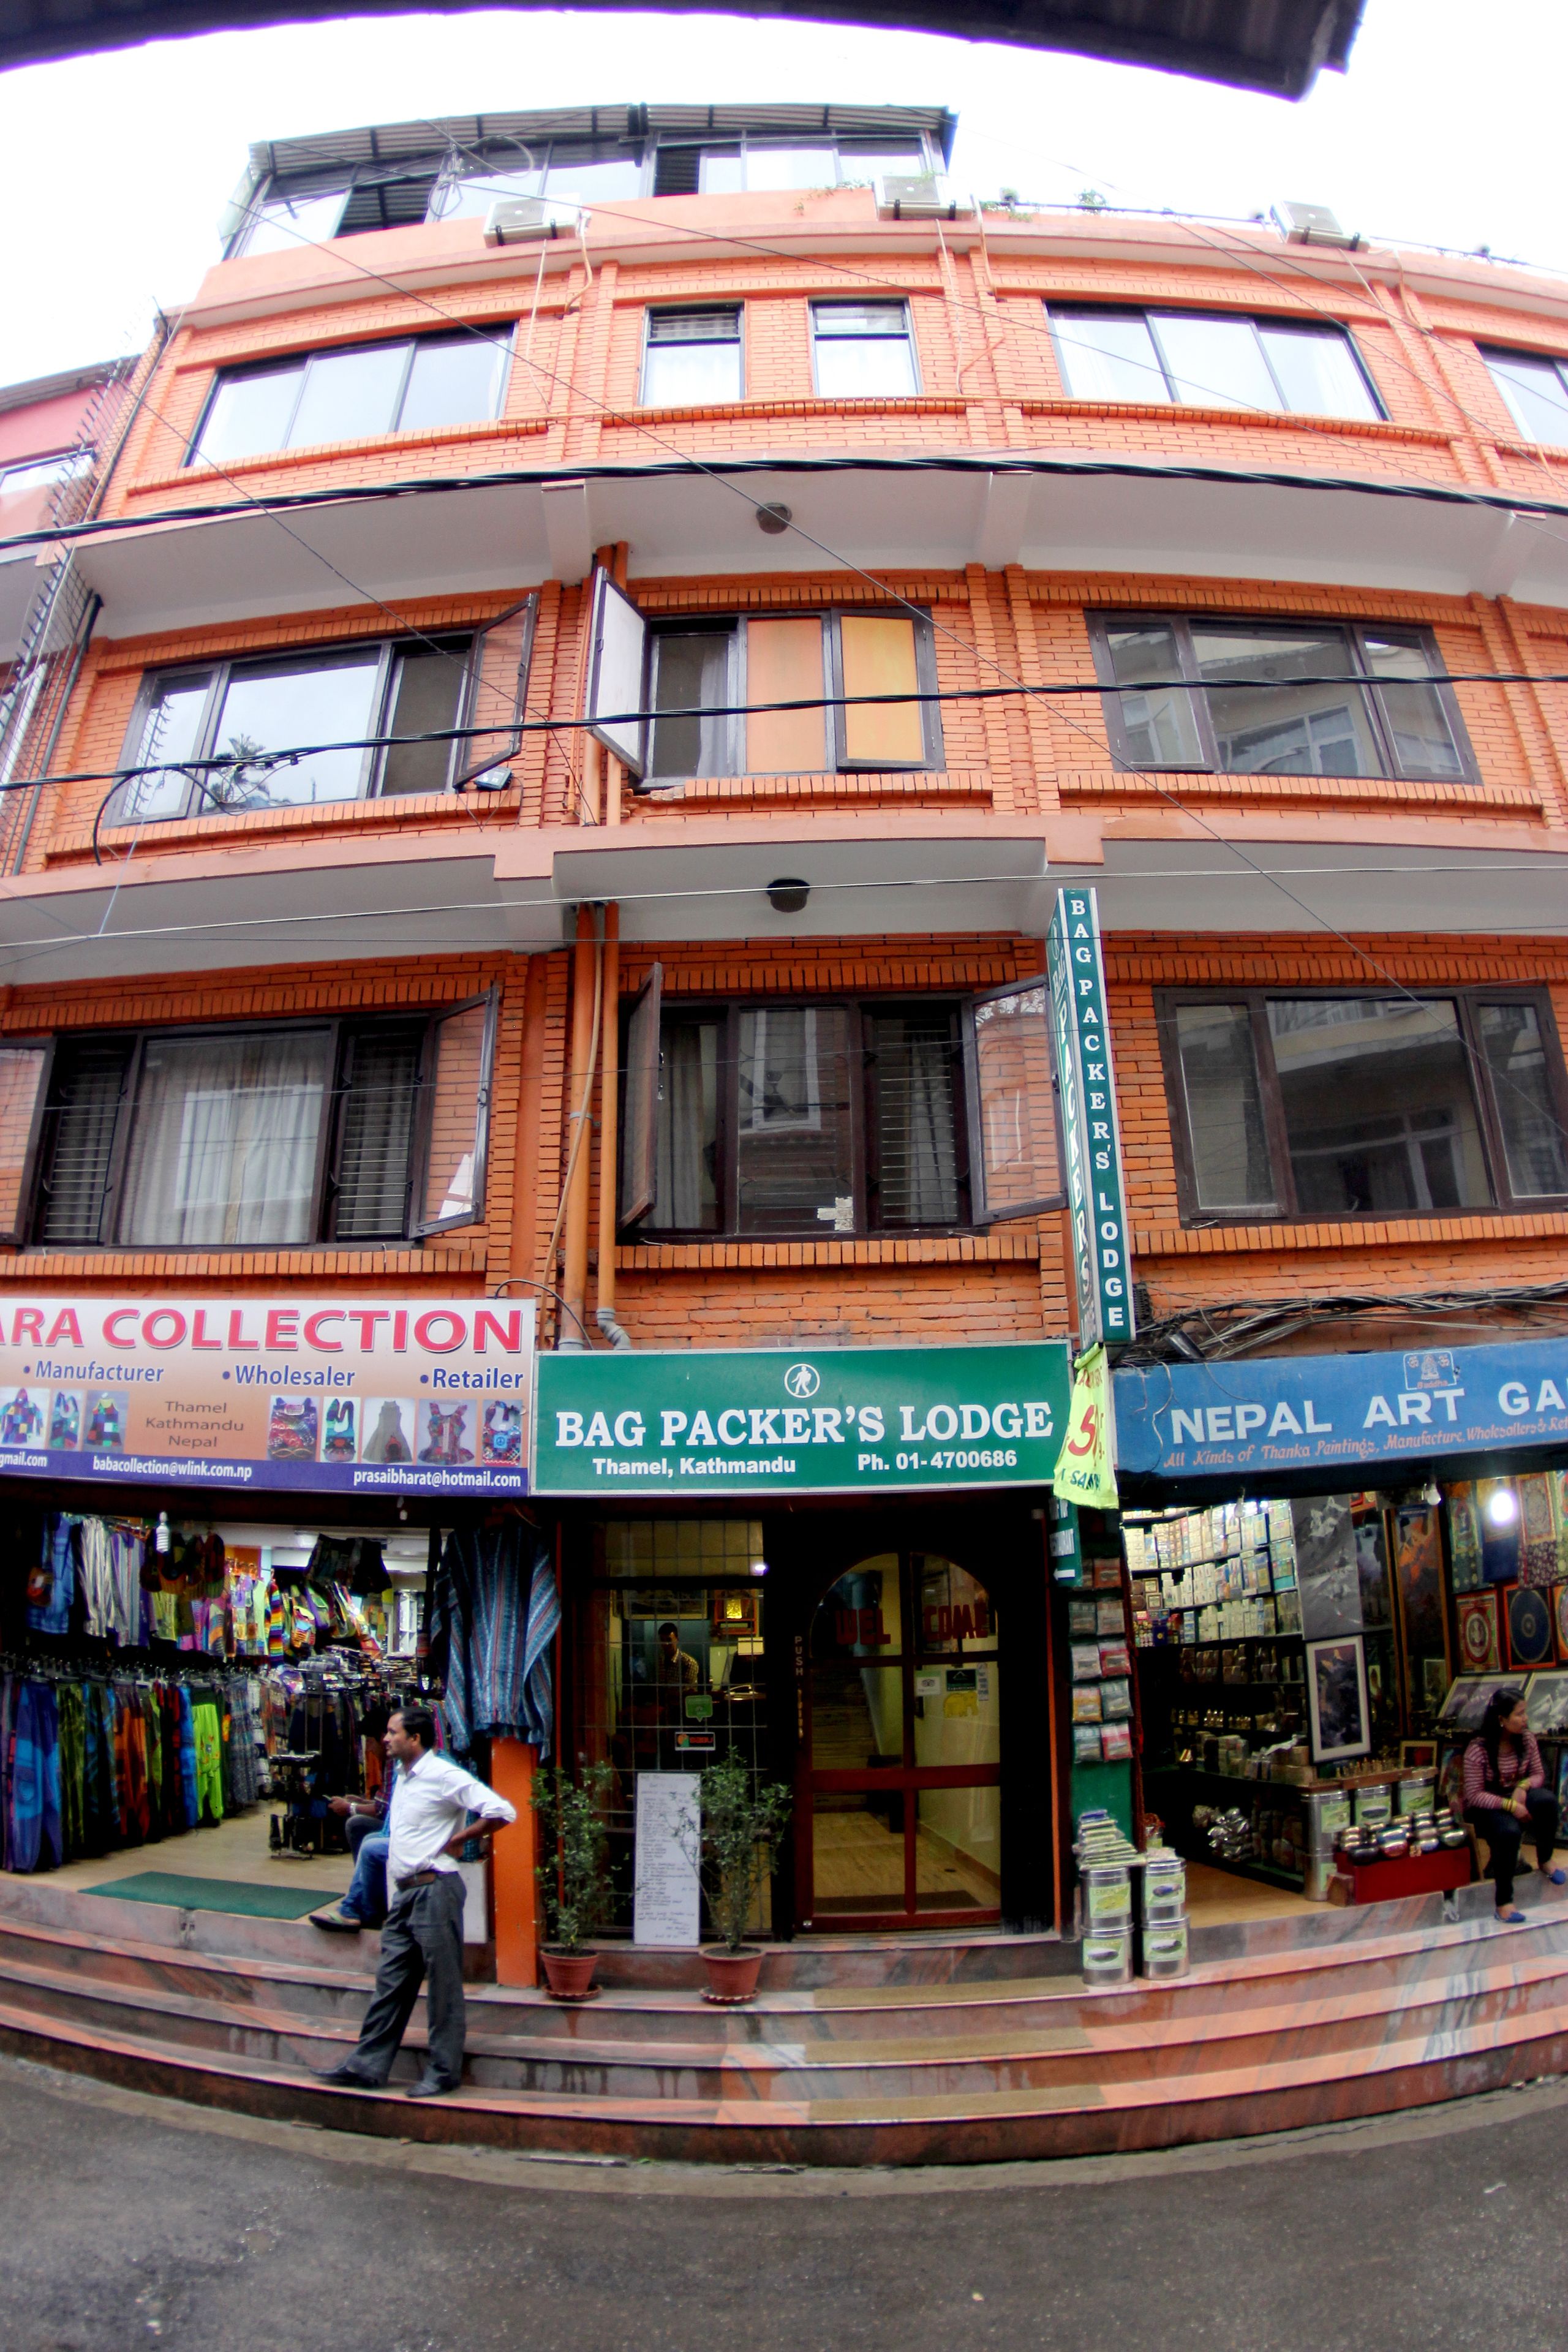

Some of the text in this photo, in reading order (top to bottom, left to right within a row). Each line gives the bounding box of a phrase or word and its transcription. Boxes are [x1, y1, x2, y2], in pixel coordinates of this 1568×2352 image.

[1071, 900, 1091, 963] BAG
[1099, 1192, 1124, 1327] LODGE
[0, 1308, 522, 1353] RA COLLECTION
[36, 1360, 164, 1382] Manufacturer
[236, 1365, 356, 1388] Wholesaler
[432, 1367, 524, 1389] Retailer
[165, 1400, 227, 1414] Thamel
[1172, 1378, 1568, 1445] NEPAL ART GA
[146, 1417, 244, 1431] Kathmandu
[556, 1402, 1054, 1447] BAG PACKER'S LODGE
[168, 1435, 217, 1449] Nepal
[593, 1455, 796, 1478] Thamel, Kathmandu
[858, 1453, 890, 1471] Ph.
[1164, 1452, 1185, 1468] All
[1193, 1449, 1234, 1466] Kinds
[1238, 1444, 1256, 1462] of
[1261, 1442, 1311, 1460] Thanka
[93, 1456, 252, 1481] babacollection@wlink.com.np
[353, 1468, 521, 1487] prasaibharat@hotmail.com
[794, 1635, 804, 1676] PUSH
